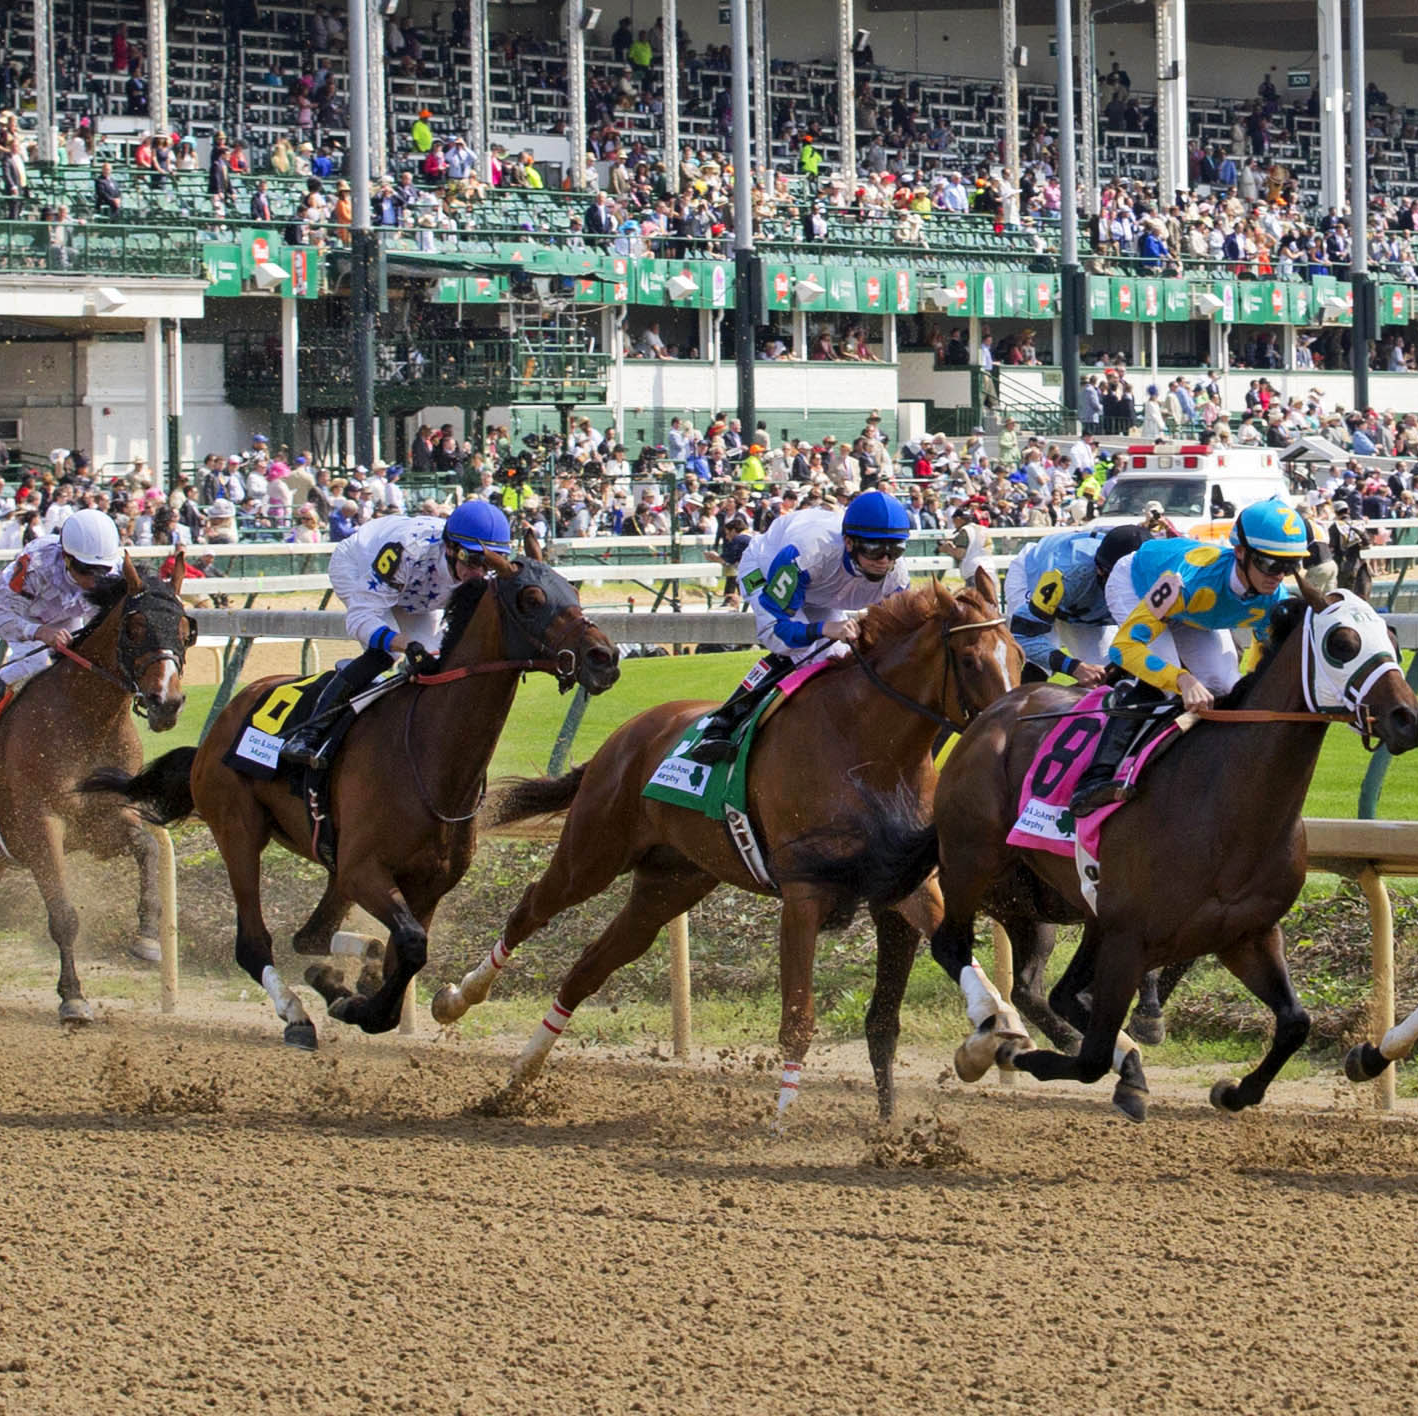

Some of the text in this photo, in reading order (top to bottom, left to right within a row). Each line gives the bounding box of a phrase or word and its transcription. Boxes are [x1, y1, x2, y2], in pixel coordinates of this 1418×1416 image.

[377, 547, 397, 575] 6
[773, 570, 793, 599] 5
[1039, 582, 1057, 605] 4
[1150, 582, 1172, 609] 8
[1032, 716, 1102, 799] 8
